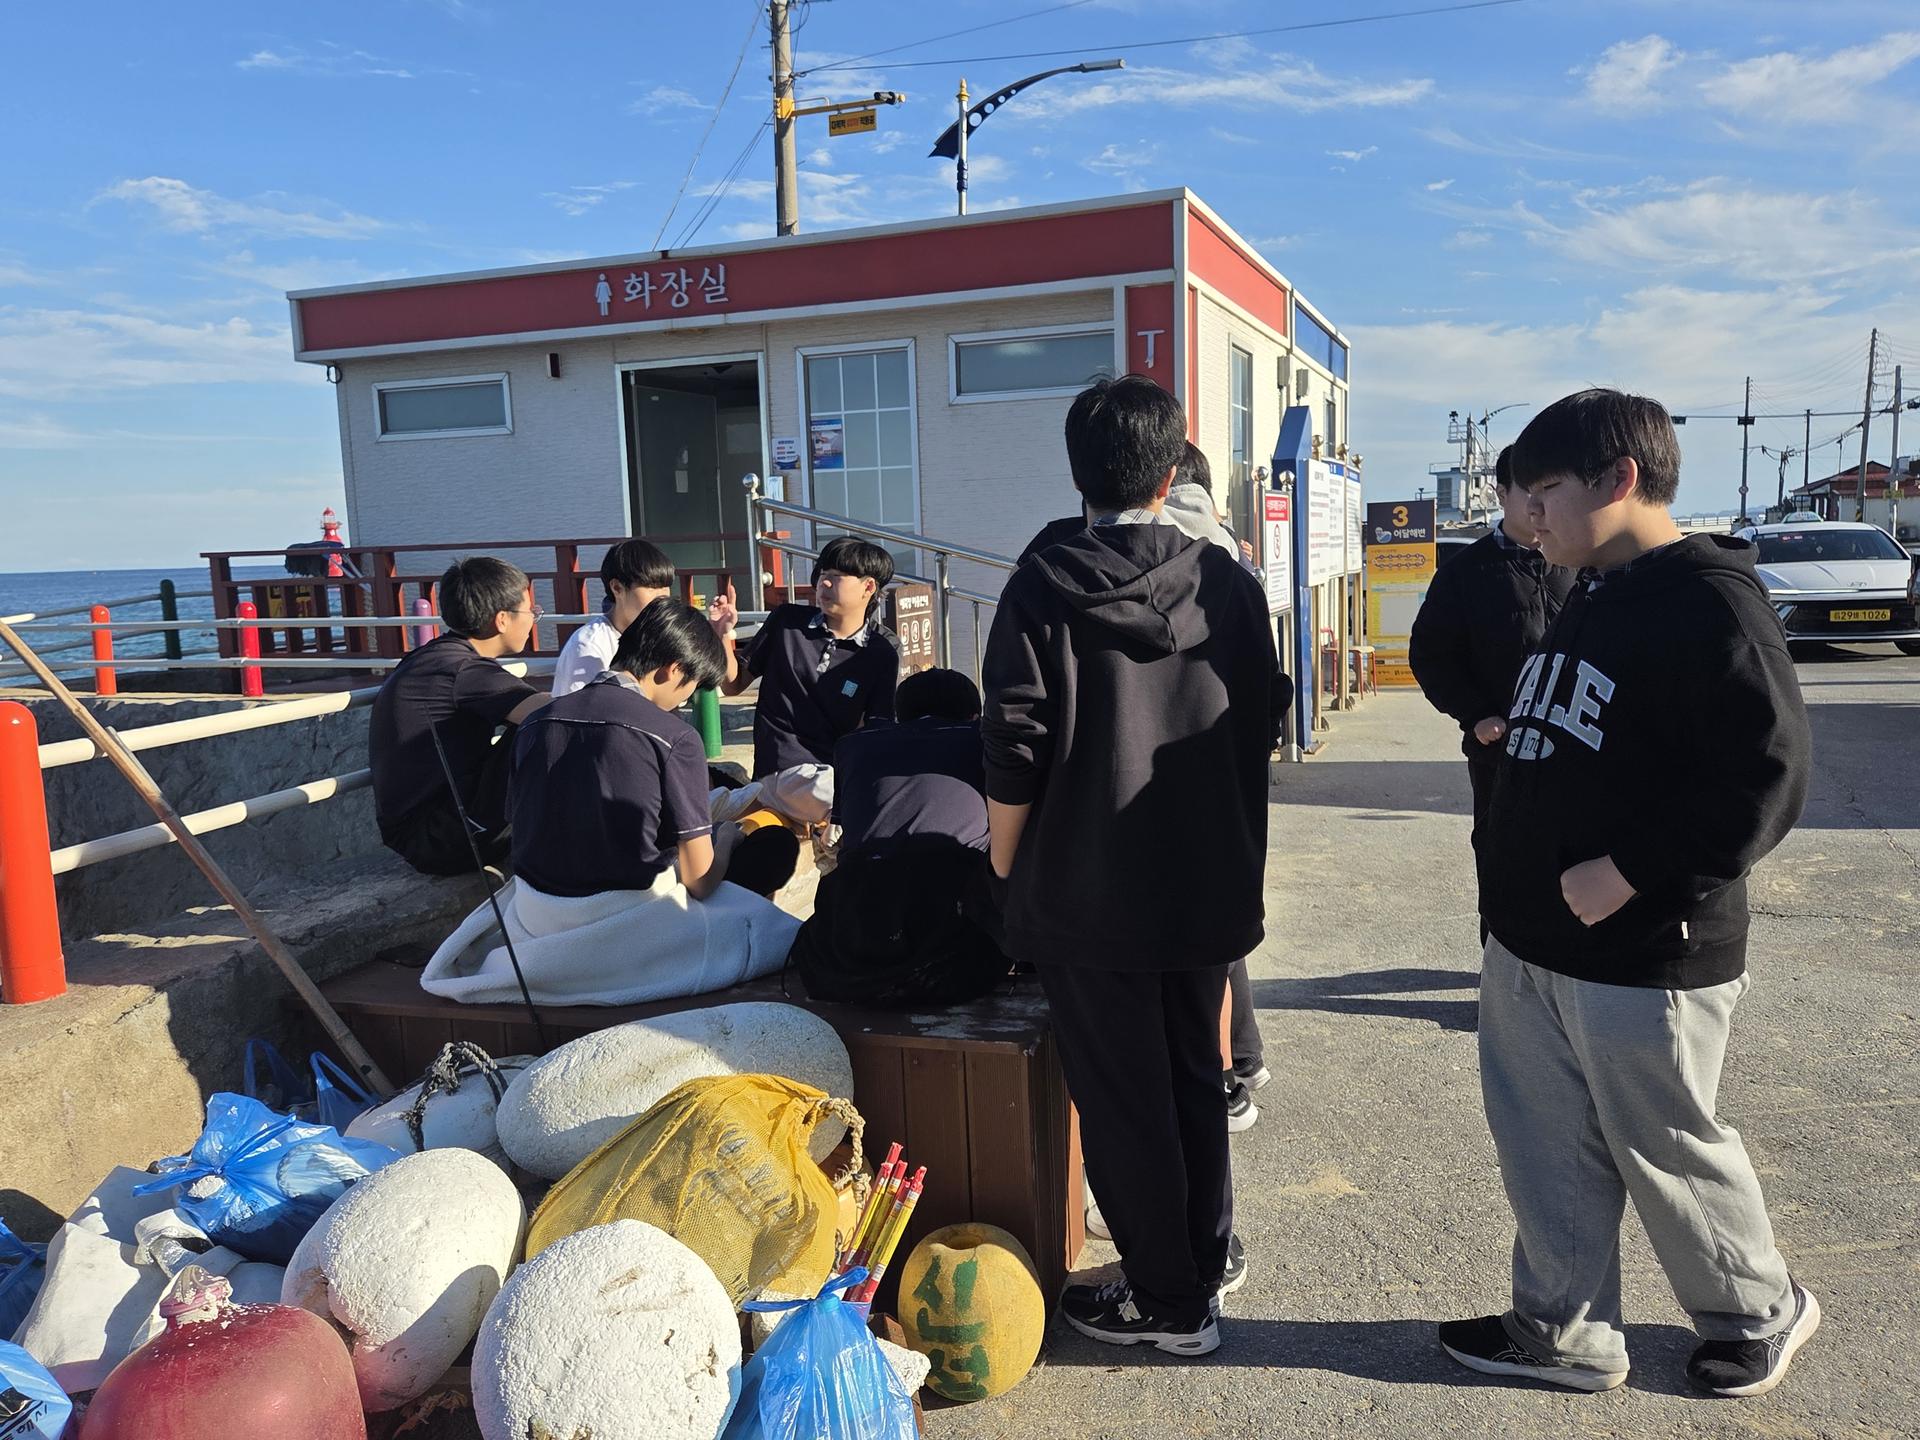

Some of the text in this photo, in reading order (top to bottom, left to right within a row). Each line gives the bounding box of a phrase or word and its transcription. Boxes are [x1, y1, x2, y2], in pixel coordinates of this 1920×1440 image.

[623, 264, 729, 309] 화장실
[1136, 329, 1166, 369] T
[1392, 505, 1409, 527] 3
[1393, 528, 1426, 539] 어달해변
[1509, 653, 1616, 752] ALE
